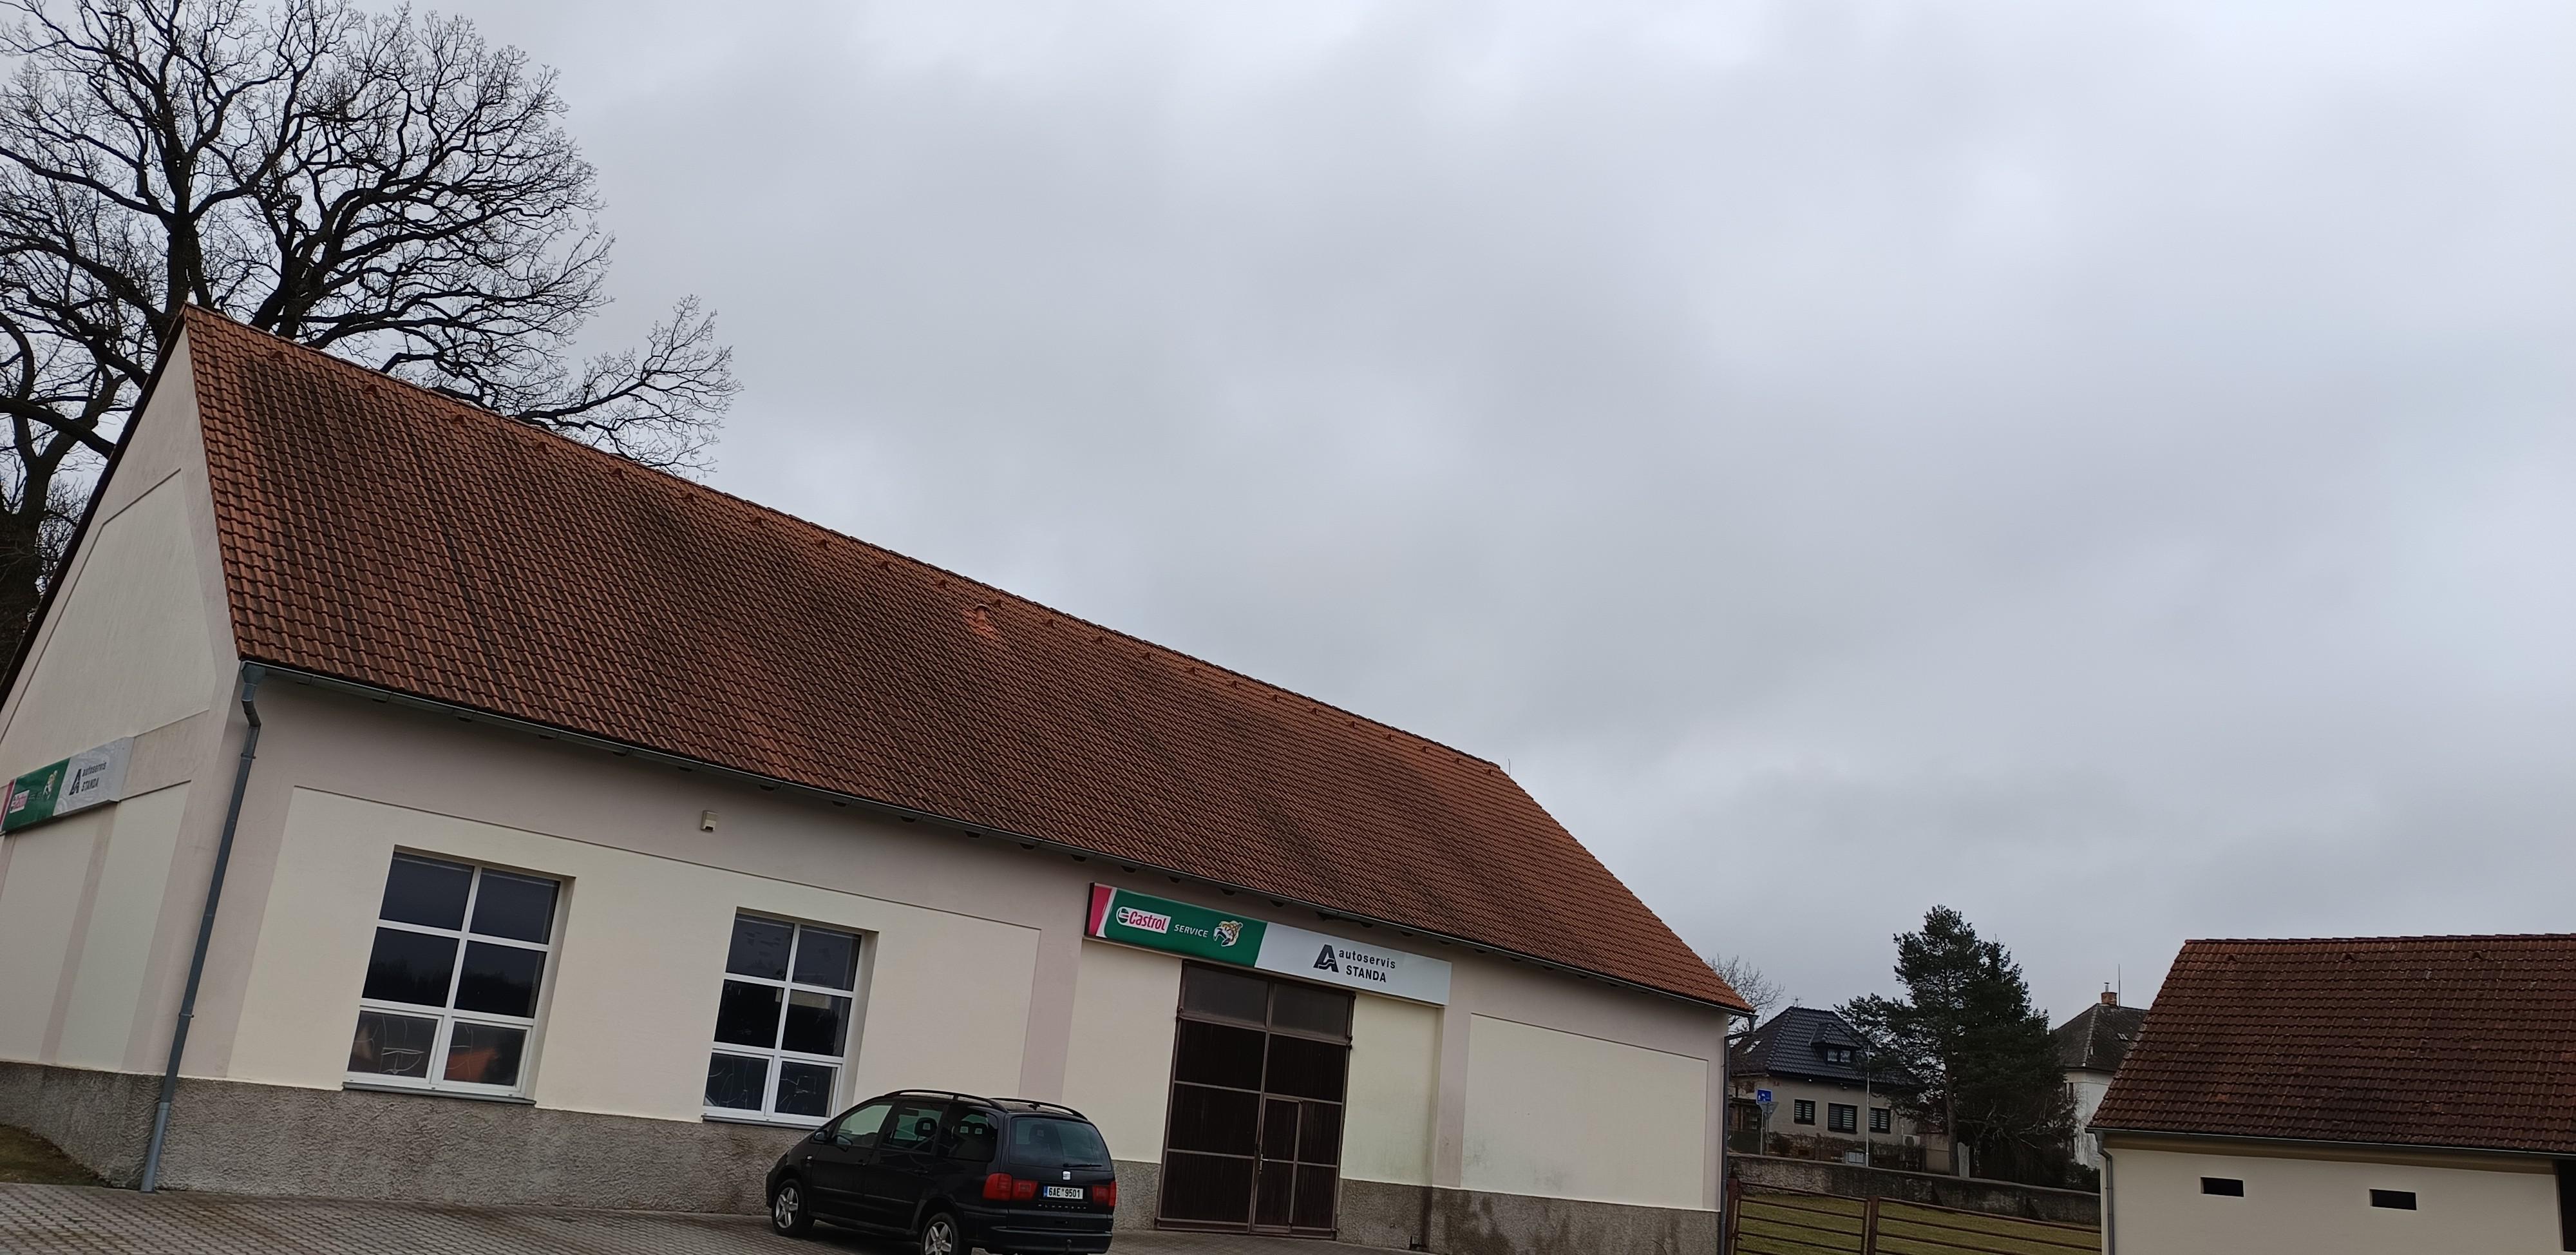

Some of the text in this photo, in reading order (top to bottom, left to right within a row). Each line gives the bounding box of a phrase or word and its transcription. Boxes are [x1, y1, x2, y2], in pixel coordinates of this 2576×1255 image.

[1129, 911, 1209, 938] Castrol SERVICE
[1339, 950, 1396, 969] autoservis
[1346, 965, 1387, 983] STANDA
[1048, 1187, 1081, 1198] 6AE 9501
